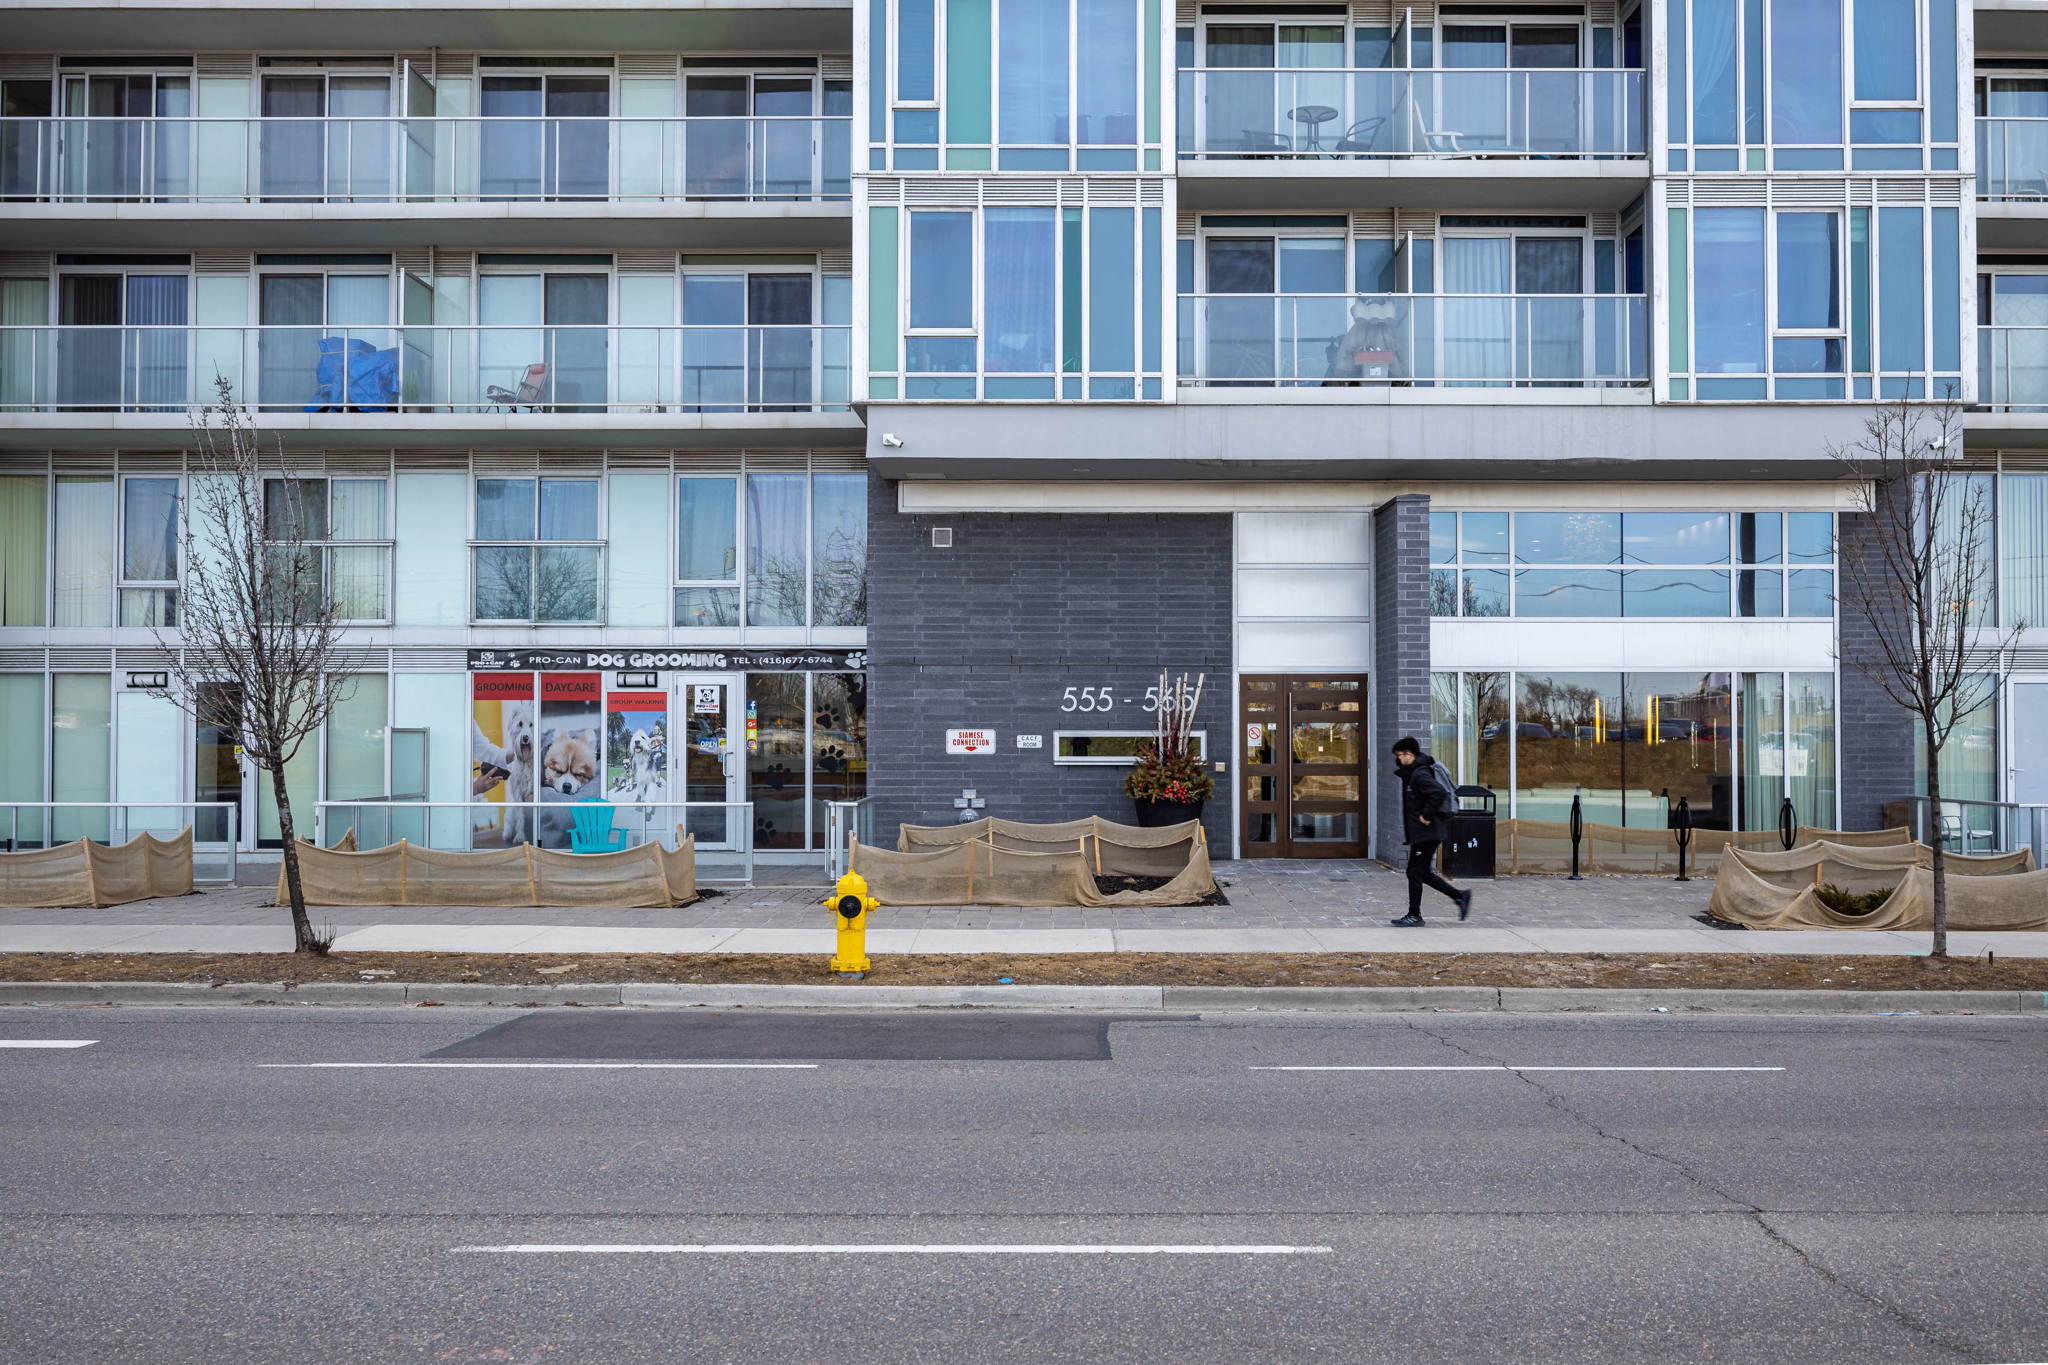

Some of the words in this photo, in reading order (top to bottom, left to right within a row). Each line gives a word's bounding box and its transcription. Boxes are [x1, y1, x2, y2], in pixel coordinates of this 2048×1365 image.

[529, 656, 581, 664] PRO-CAN
[586, 653, 625, 668] DOG
[629, 653, 727, 668] GROOMING
[759, 656, 833, 665] (416)677-6744
[475, 682, 533, 692] GROOMING
[544, 682, 597, 692] DAYCARE
[1060, 687, 1113, 712] 555
[1142, 687, 1195, 712] 565
[958, 731, 984, 739] SIAMESE
[700, 740, 718, 748] OPEN
[952, 738, 990, 746] CONNECTION
